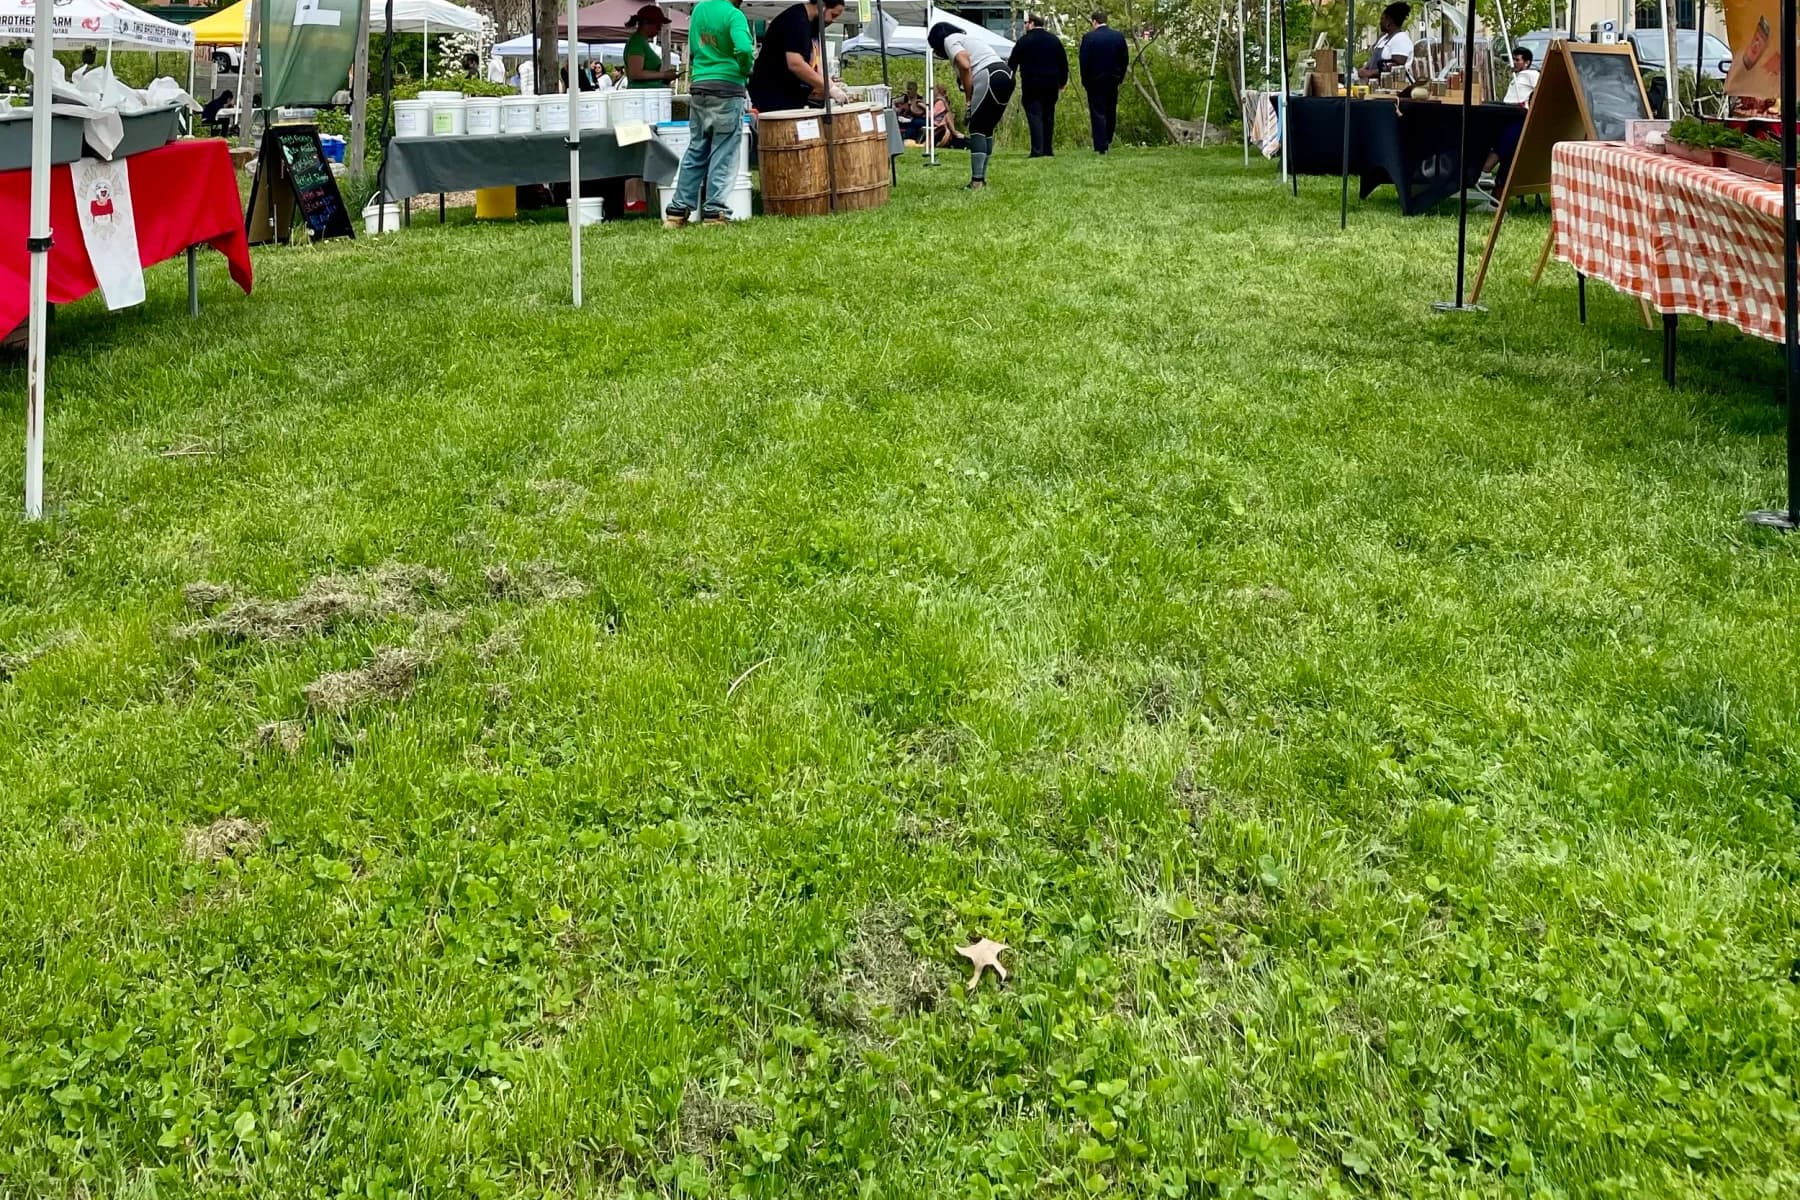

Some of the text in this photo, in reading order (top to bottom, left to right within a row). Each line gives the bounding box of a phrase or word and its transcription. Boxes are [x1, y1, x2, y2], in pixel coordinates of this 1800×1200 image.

[0, 15, 72, 28] ROTHER ARM
[8, 26, 35, 34] VEGETALE
